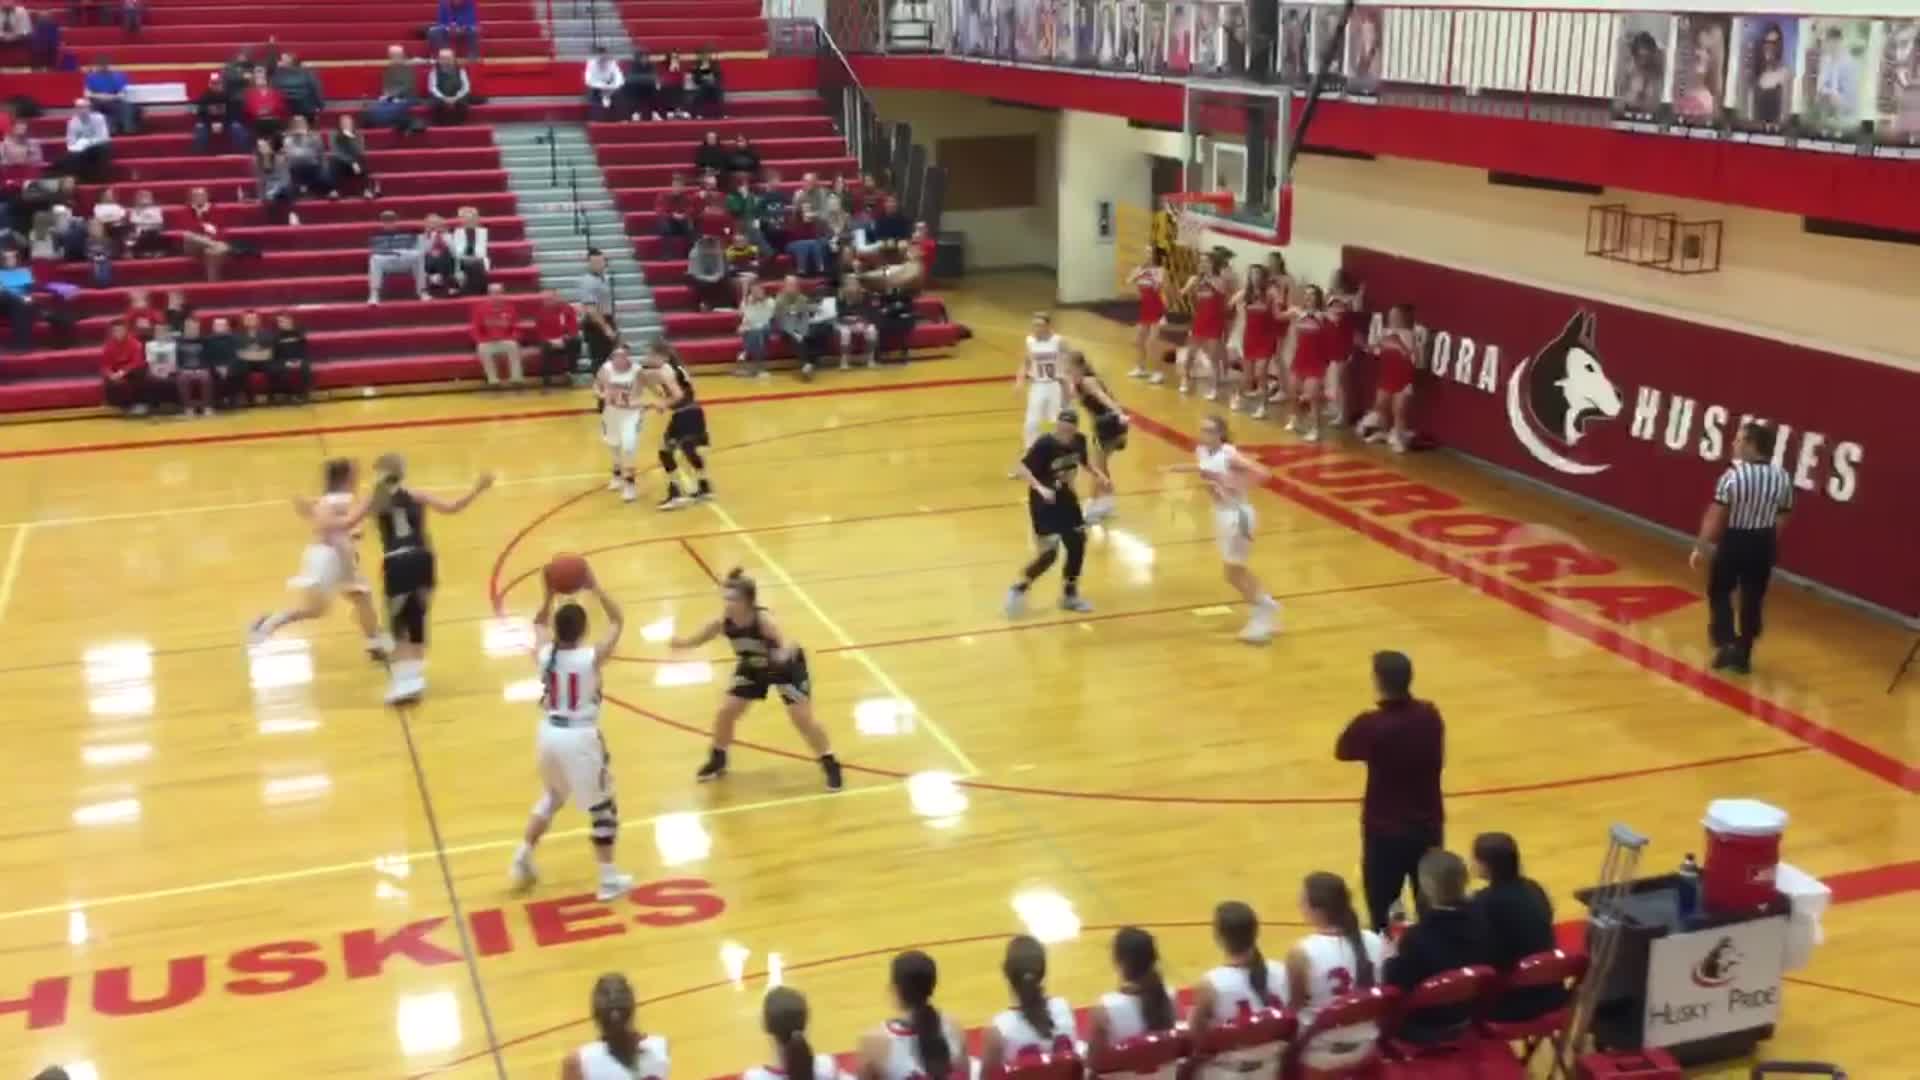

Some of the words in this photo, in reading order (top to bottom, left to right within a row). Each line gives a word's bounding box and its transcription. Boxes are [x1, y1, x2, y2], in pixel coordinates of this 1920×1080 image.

[1367, 310, 1500, 394] ARORA
[1236, 441, 1704, 622] AURORA
[548, 670, 581, 712] 11
[0, 877, 728, 1030] HUSKIES
